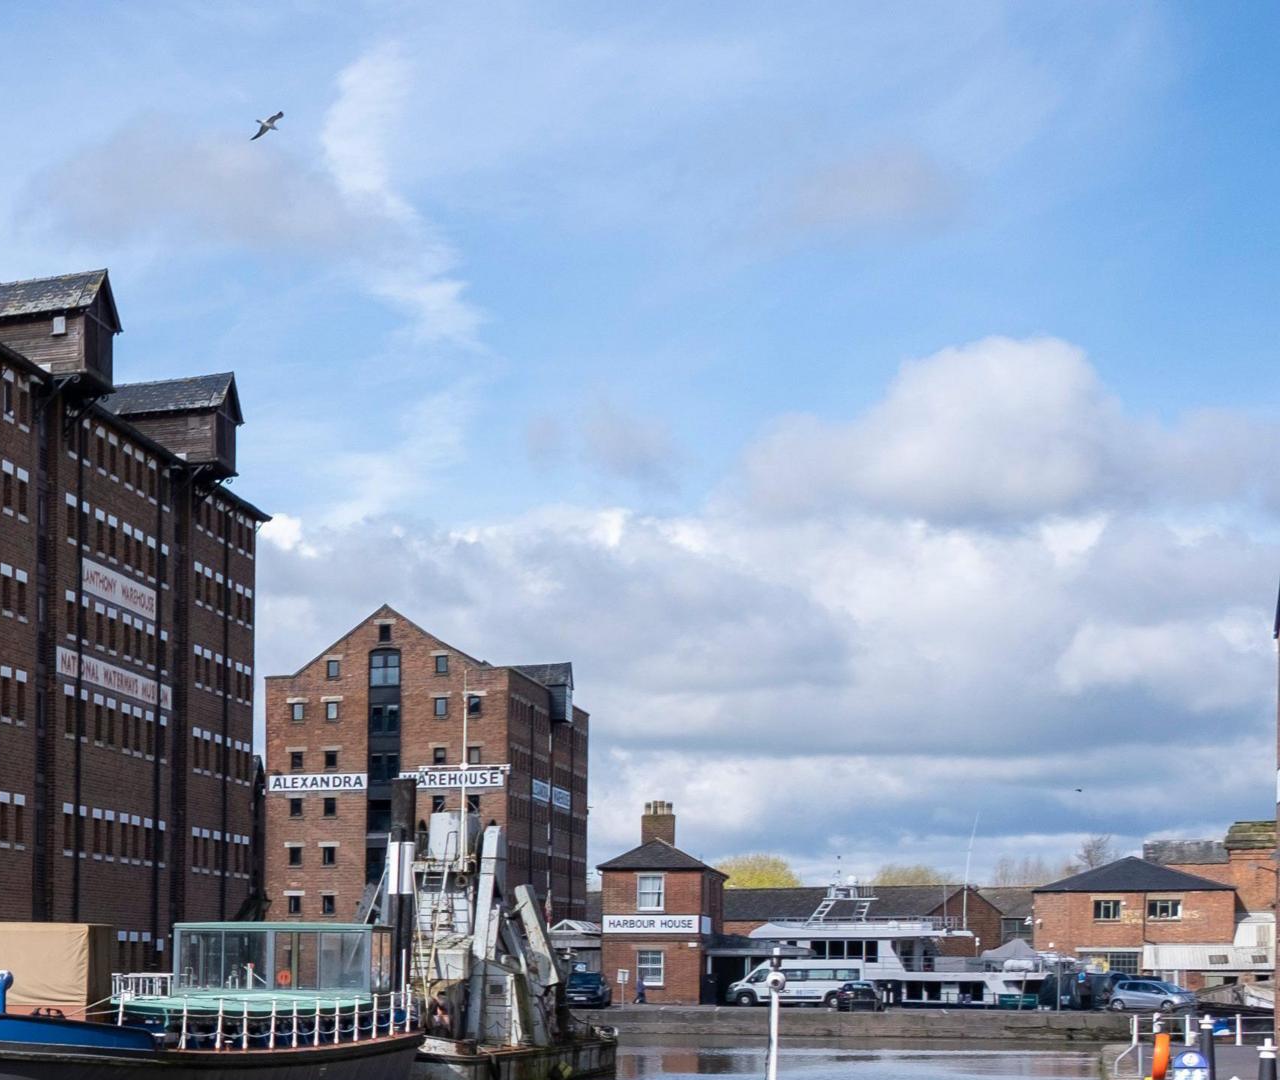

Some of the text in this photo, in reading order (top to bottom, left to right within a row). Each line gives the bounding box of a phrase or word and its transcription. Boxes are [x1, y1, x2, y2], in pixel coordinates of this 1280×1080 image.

[272, 775, 364, 790] ALEXANDRA
[608, 919, 693, 928] HARBOUR HOUSE
